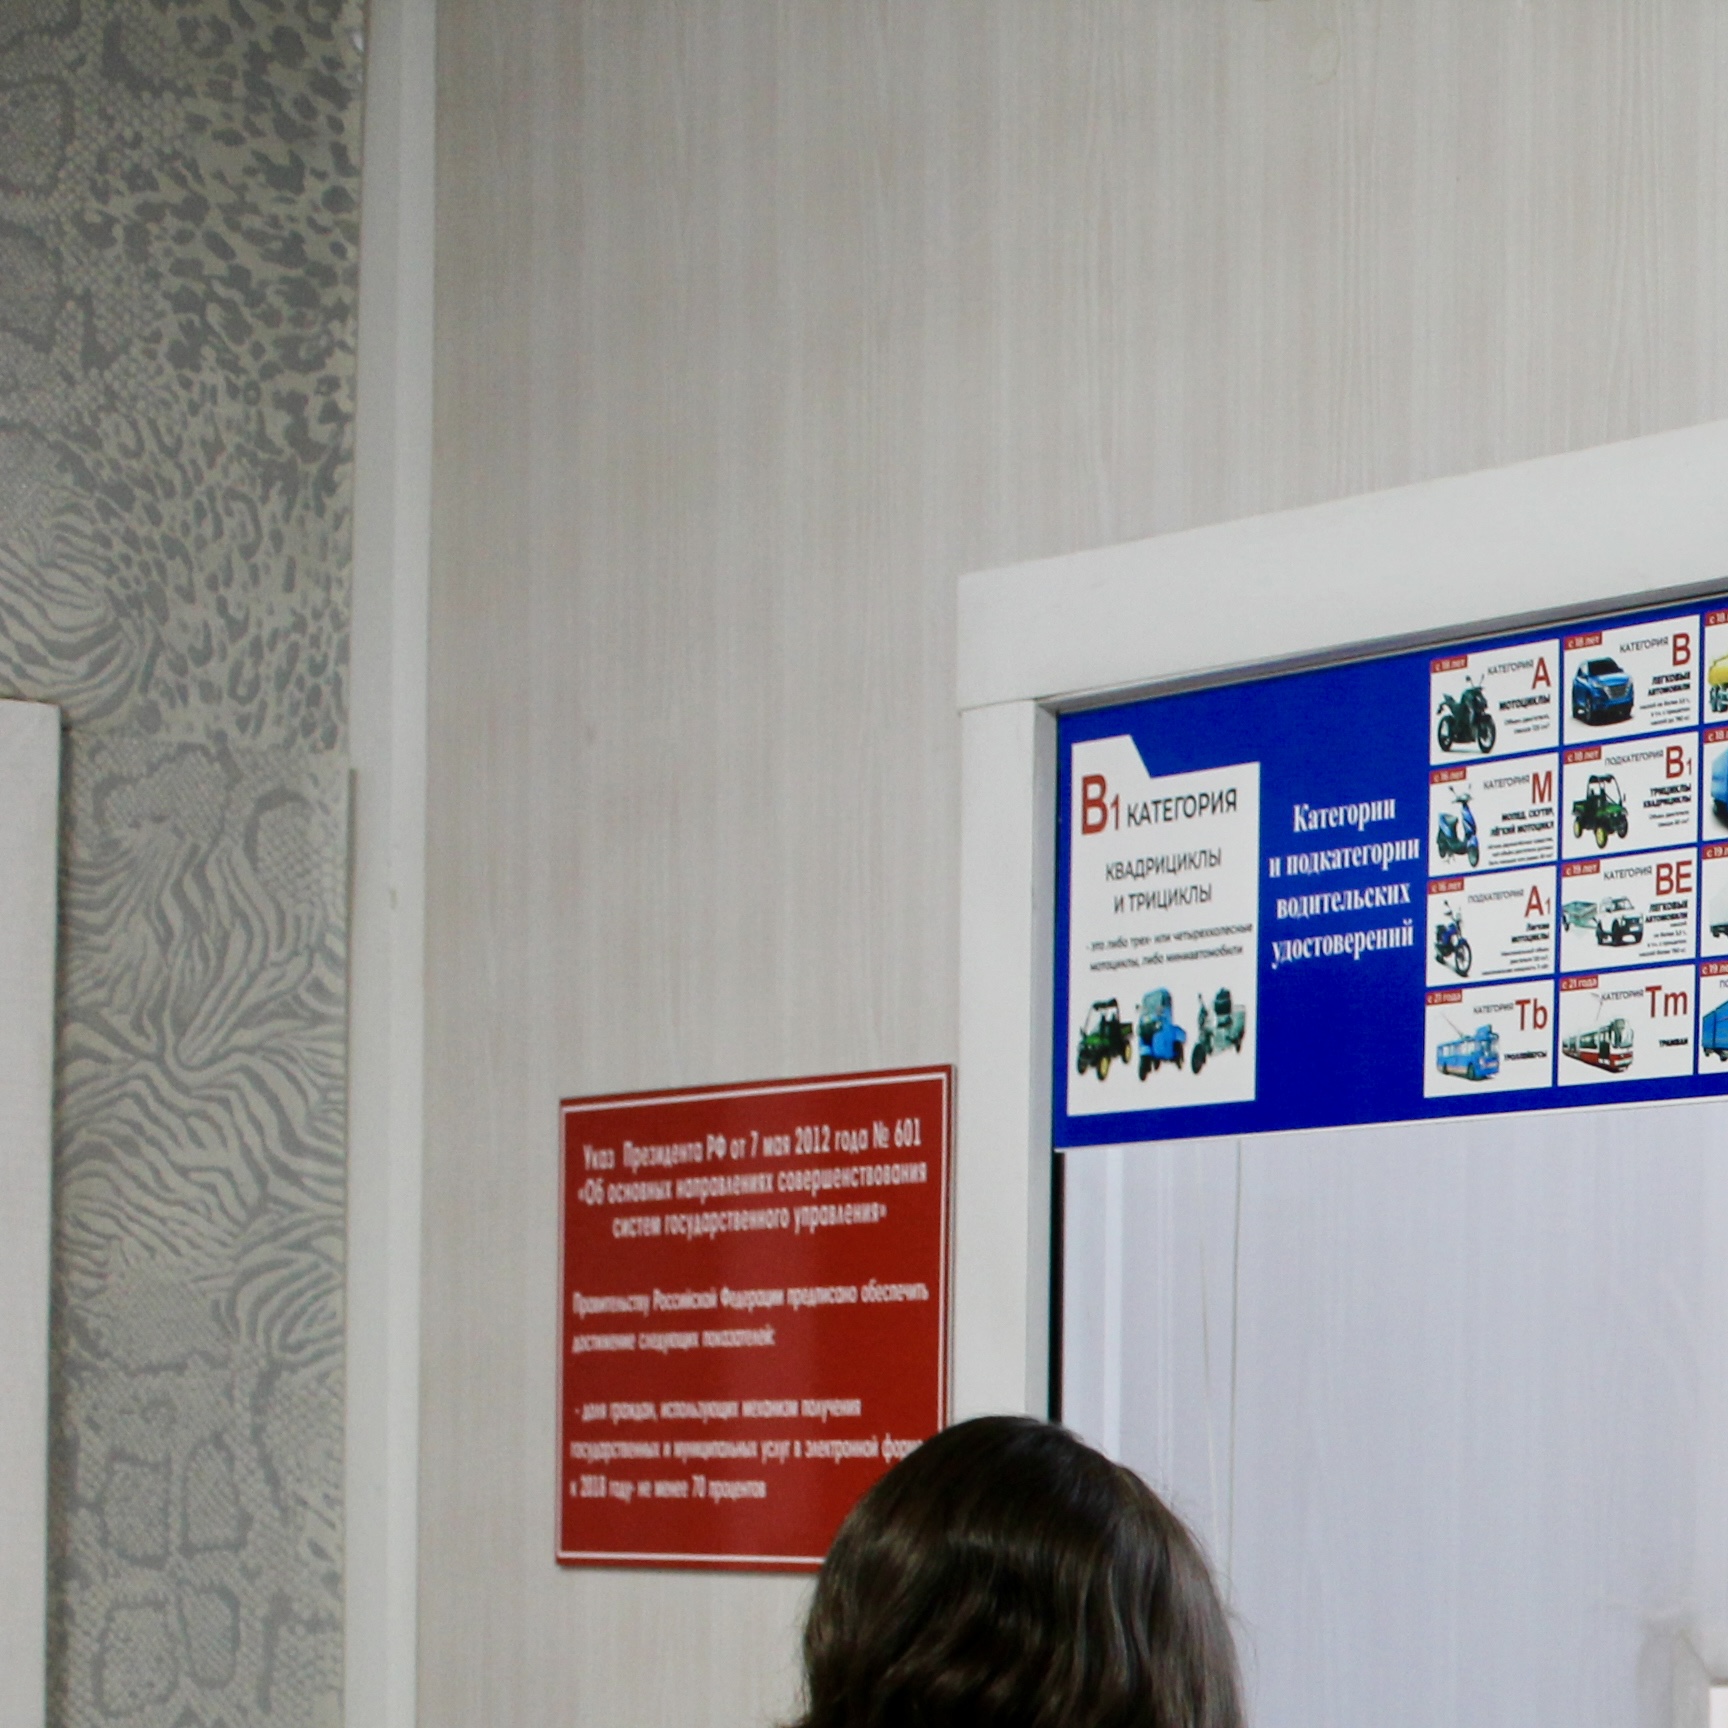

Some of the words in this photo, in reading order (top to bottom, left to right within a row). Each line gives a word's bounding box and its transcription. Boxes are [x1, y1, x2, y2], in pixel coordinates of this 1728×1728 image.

[1619, 637, 1669, 653] КАТЕГОРИЯ
[1487, 659, 1534, 676] КАТЕГОРИЯ
[1604, 750, 1664, 767] ПОДКАТЕГОРИЯ
[1666, 745, 1692, 779] B1
[1483, 774, 1531, 790] КАТЕГОРИЯ
[1127, 787, 1237, 827] КАТЕГОРИЯ
[1293, 798, 1395, 833] Категории
[1105, 848, 1222, 881] КВАДРИЦИКЛЫ
[1269, 857, 1281, 878] и
[1286, 838, 1420, 876] подкатегории
[1603, 865, 1652, 880] КАТЕГОРИЯ
[1655, 860, 1693, 896] BE
[1114, 894, 1125, 914] И
[1128, 883, 1212, 912] ТРИЦИКЛЫ
[1277, 882, 1411, 919] водительских
[1271, 920, 1414, 970] удостоверений
[1602, 989, 1644, 1001] КАТЕГОРИЯ
[1645, 985, 1688, 1018] Tm
